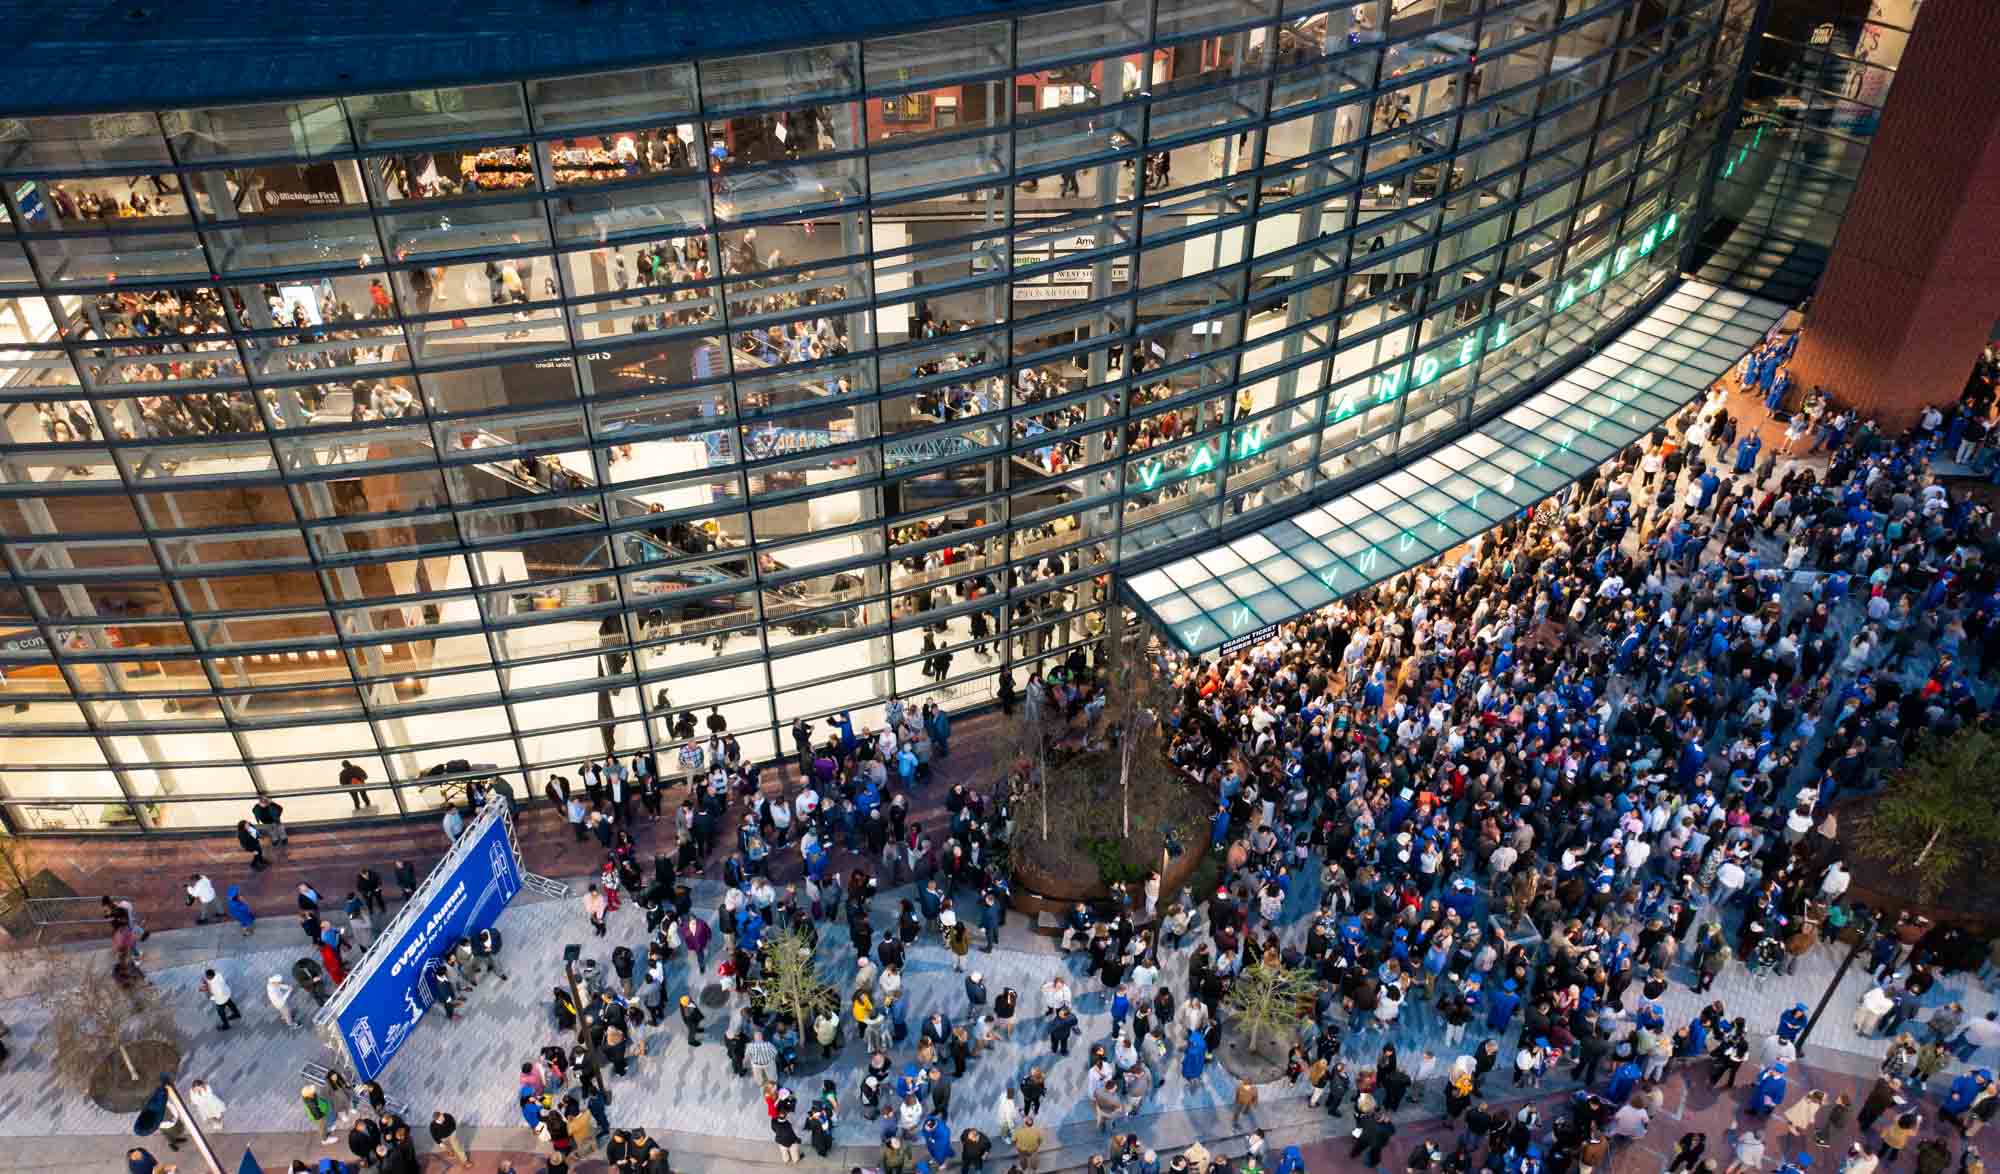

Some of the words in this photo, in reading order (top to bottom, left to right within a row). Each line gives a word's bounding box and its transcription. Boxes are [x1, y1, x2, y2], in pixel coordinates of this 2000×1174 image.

[1334, 322, 1508, 422] ANDEL
[1139, 426, 1262, 489] VAN
[1223, 635, 1250, 648] SEASON
[1252, 625, 1277, 637] TICKET
[1223, 640, 1252, 654] MEMBER
[1253, 631, 1275, 644] ENTRY
[391, 931, 426, 976] GVSU
[427, 880, 465, 936] Alumni
